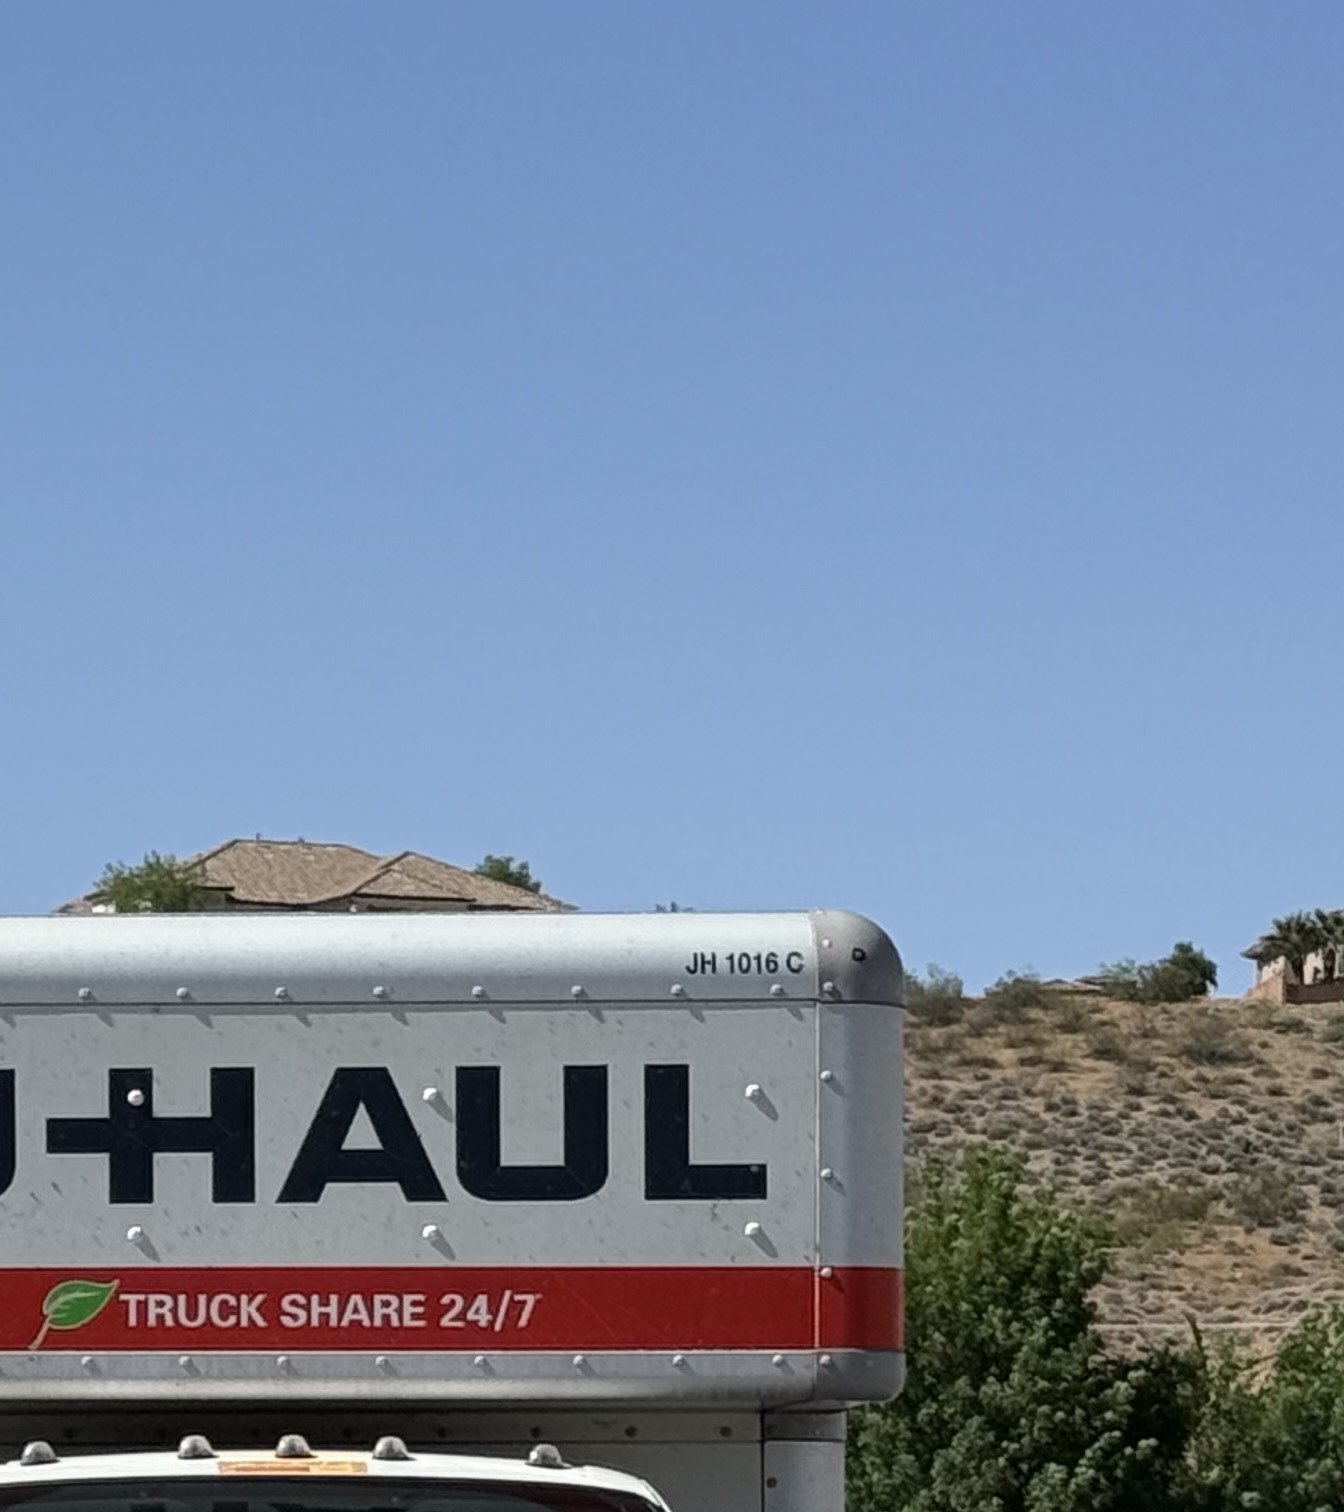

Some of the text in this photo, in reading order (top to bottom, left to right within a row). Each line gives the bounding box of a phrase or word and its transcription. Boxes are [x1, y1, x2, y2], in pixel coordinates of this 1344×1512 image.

[685, 951, 805, 975] JH 1016 C
[120, 1291, 539, 1333] TRUCK SHARE 24/7
